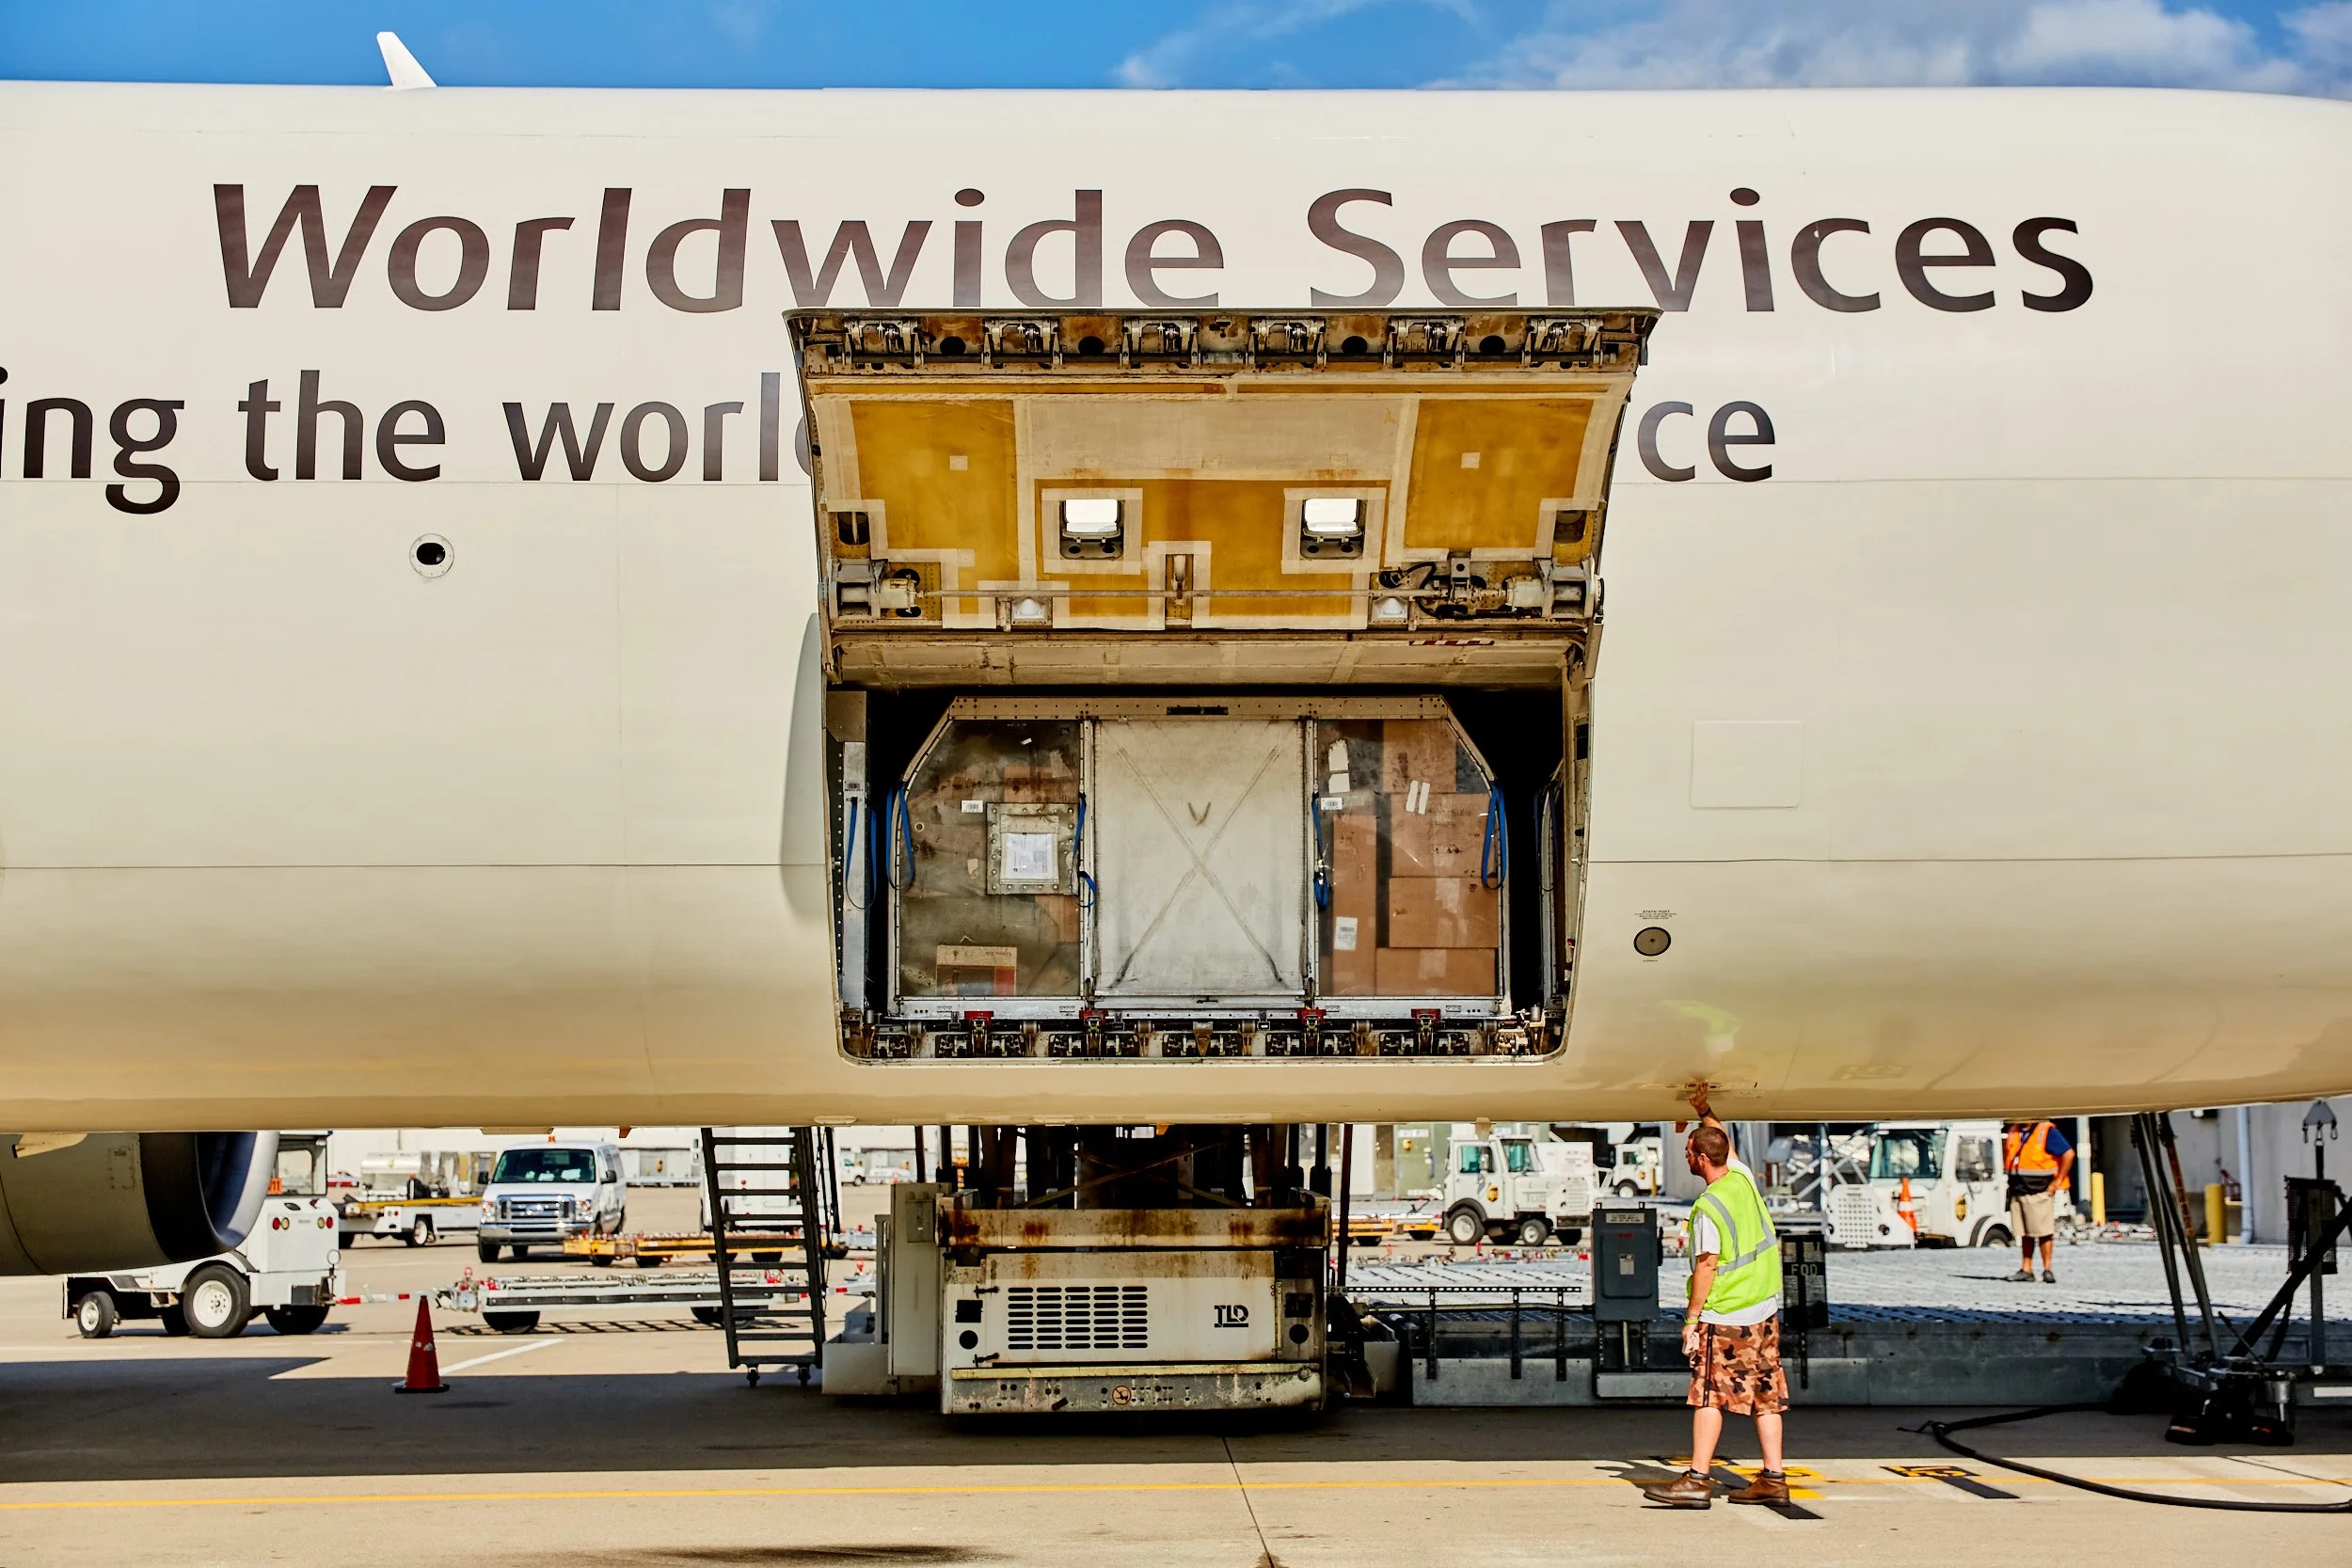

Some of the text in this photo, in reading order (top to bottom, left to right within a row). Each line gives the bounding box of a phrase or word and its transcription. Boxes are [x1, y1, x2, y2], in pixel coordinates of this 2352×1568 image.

[213, 183, 2094, 313] Worldwide Services
[237, 369, 446, 483] the
[501, 372, 812, 483] worl
[1214, 1305, 1249, 1328] TLD
